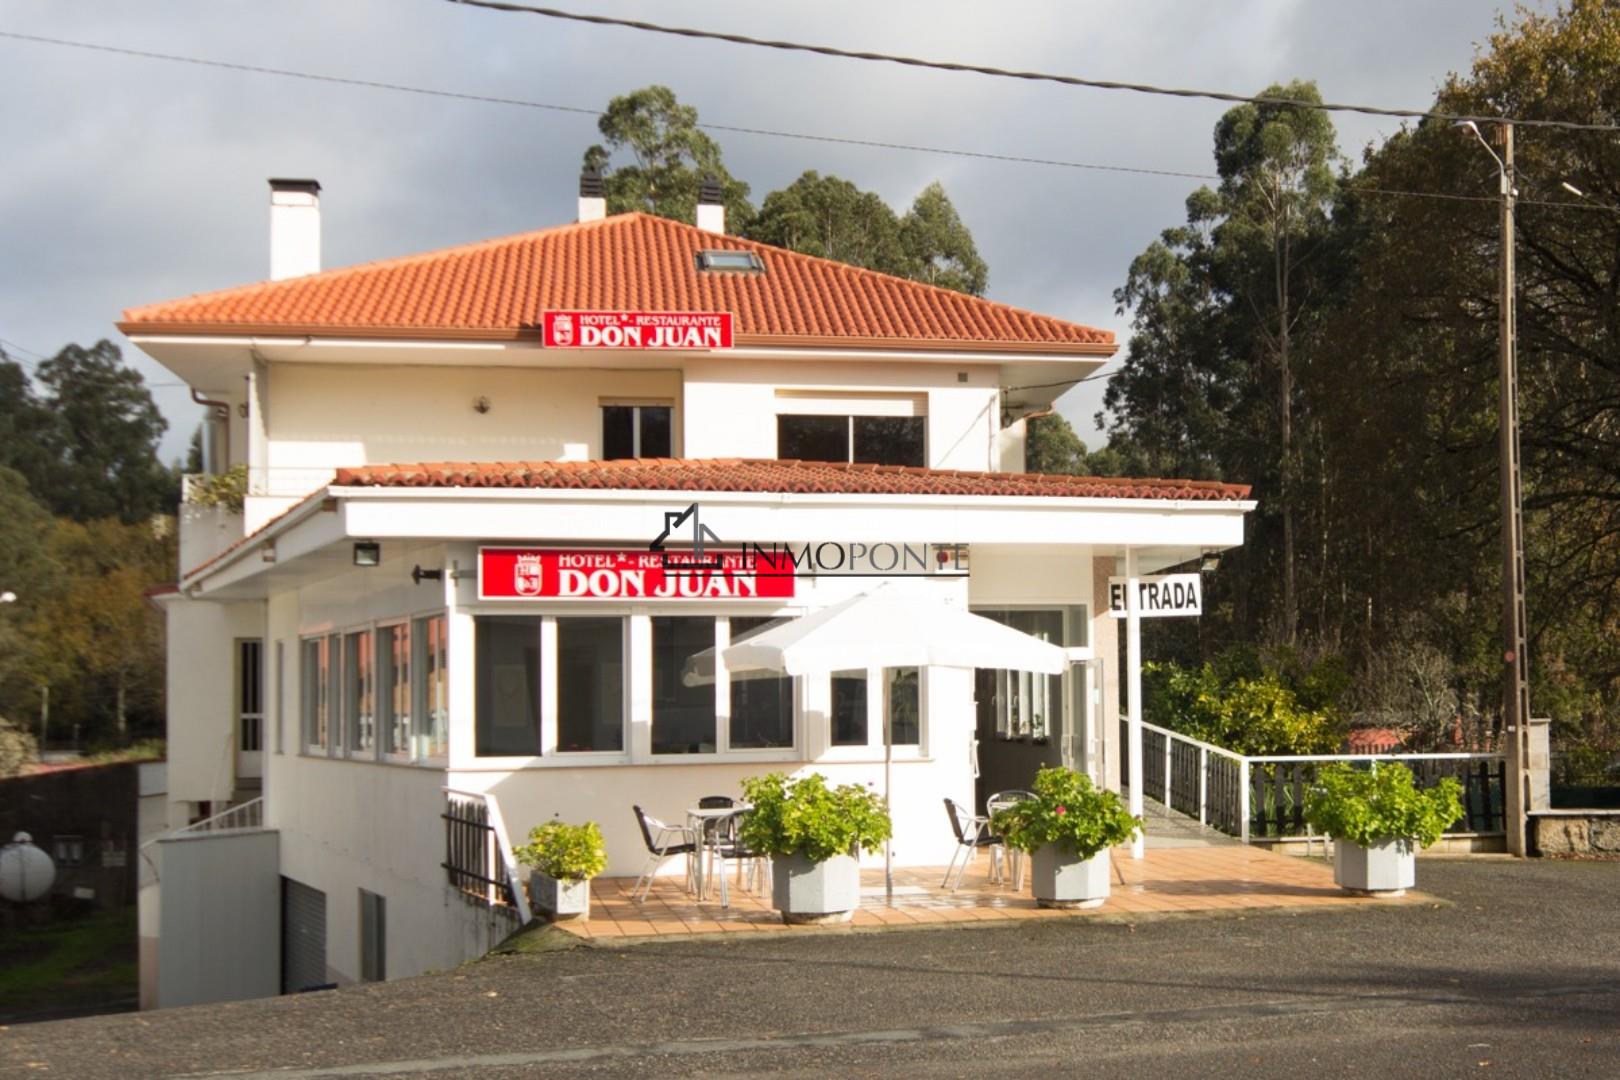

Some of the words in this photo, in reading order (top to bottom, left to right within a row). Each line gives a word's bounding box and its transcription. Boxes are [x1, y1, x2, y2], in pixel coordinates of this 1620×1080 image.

[579, 315, 620, 325] HOTEL
[636, 316, 721, 326] RESTAURANTE
[579, 326, 642, 346] DON
[648, 327, 722, 346] JUAN
[558, 554, 615, 568] HOTEL
[638, 554, 757, 569] RETARNTE
[558, 569, 646, 597] DON
[653, 569, 758, 597] JUAN
